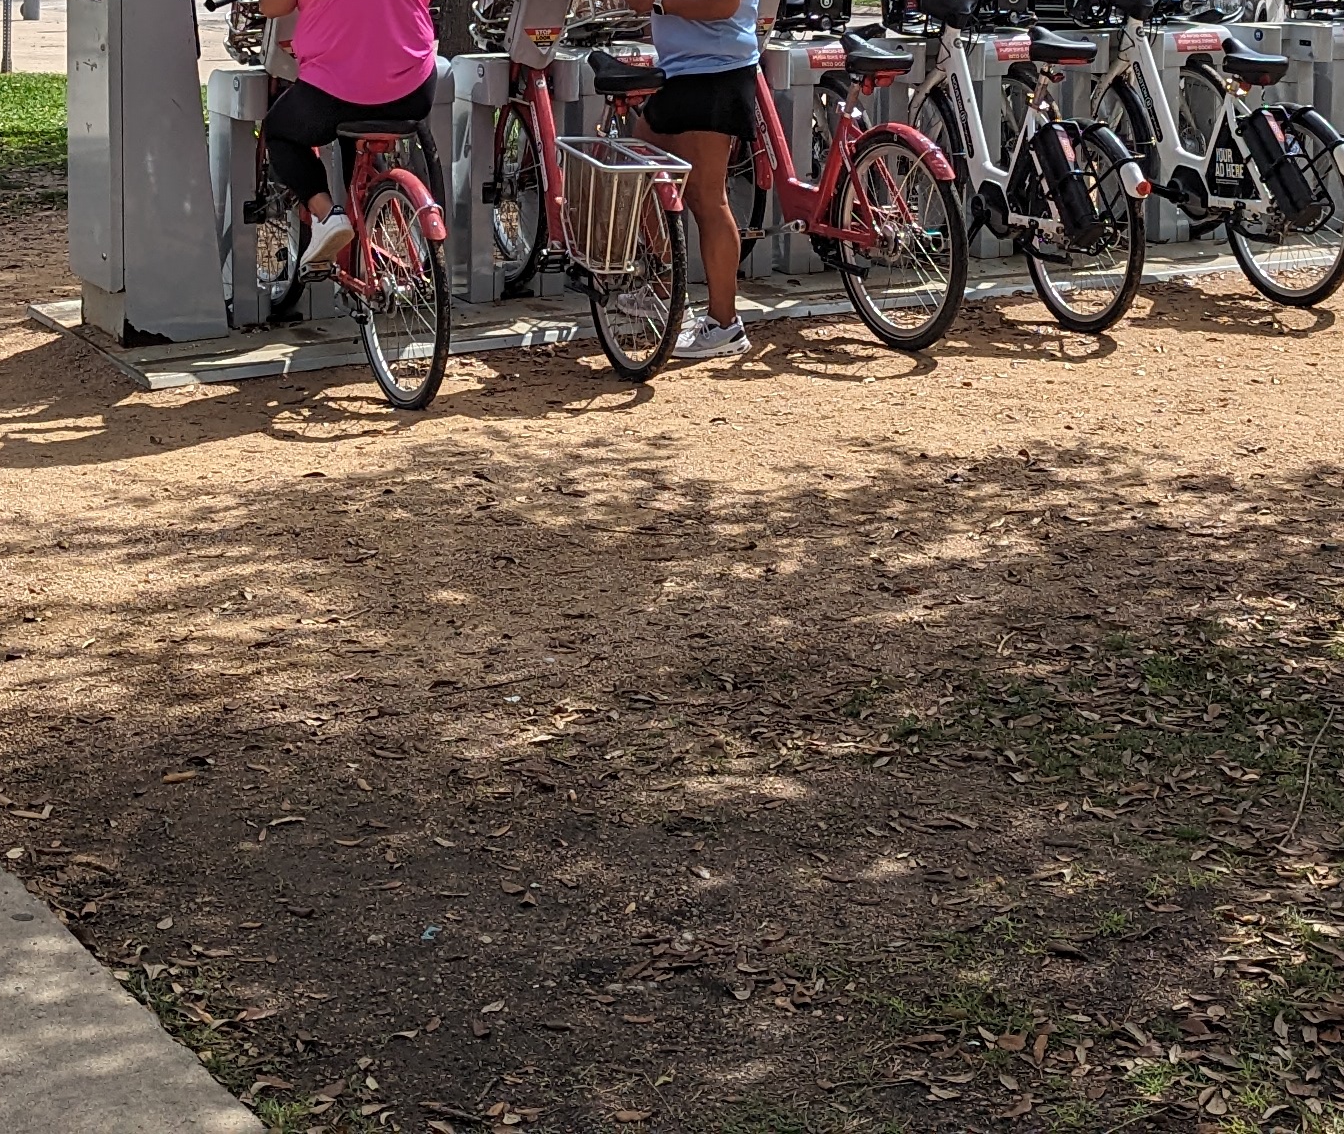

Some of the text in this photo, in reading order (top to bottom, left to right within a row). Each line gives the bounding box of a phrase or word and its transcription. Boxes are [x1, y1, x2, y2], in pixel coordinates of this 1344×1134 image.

[952, 75, 965, 111] HOUSTON
[1133, 63, 1148, 98] HOUSTON
[1215, 148, 1233, 162] YOUR
[1215, 164, 1244, 179] AD HERE
